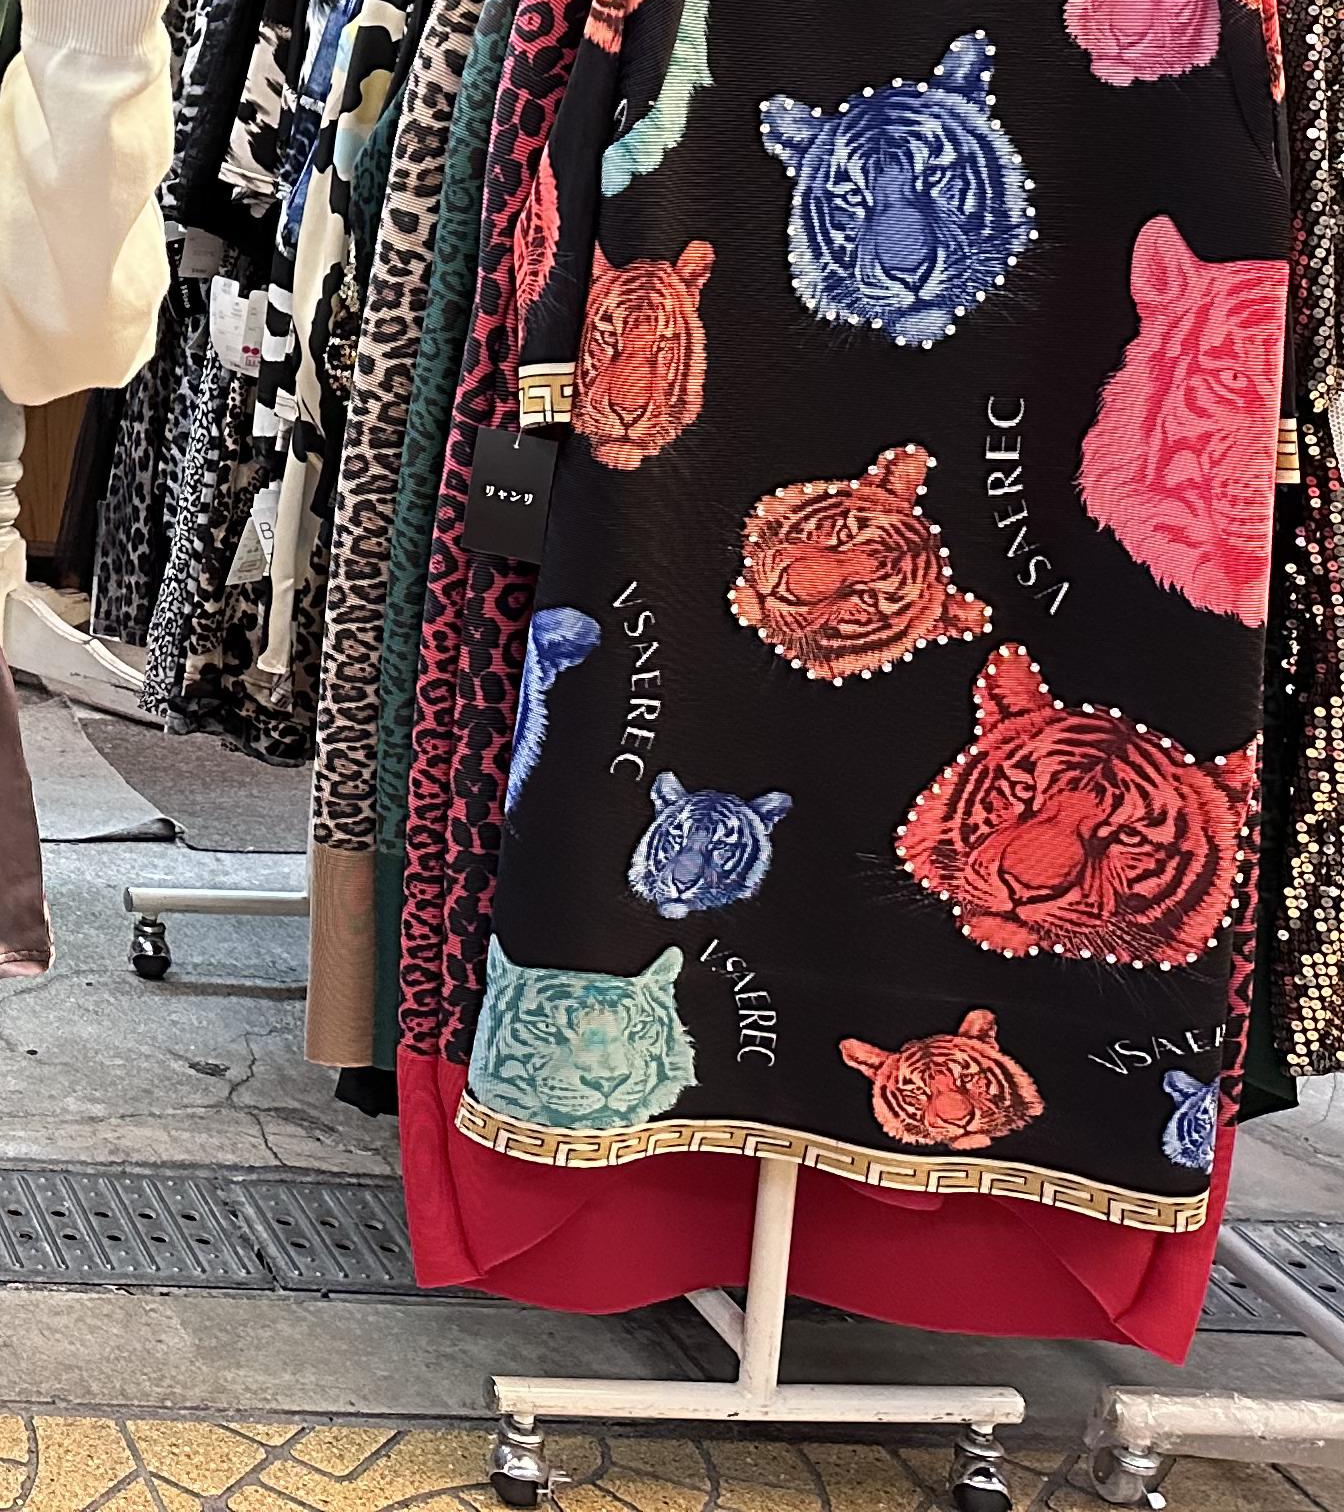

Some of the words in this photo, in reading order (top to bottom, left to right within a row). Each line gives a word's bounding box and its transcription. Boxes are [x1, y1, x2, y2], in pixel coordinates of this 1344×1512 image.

[485, 484, 534, 506] リャンリ
[985, 395, 1070, 616] VSAEREC
[610, 580, 662, 781] VSAEREC
